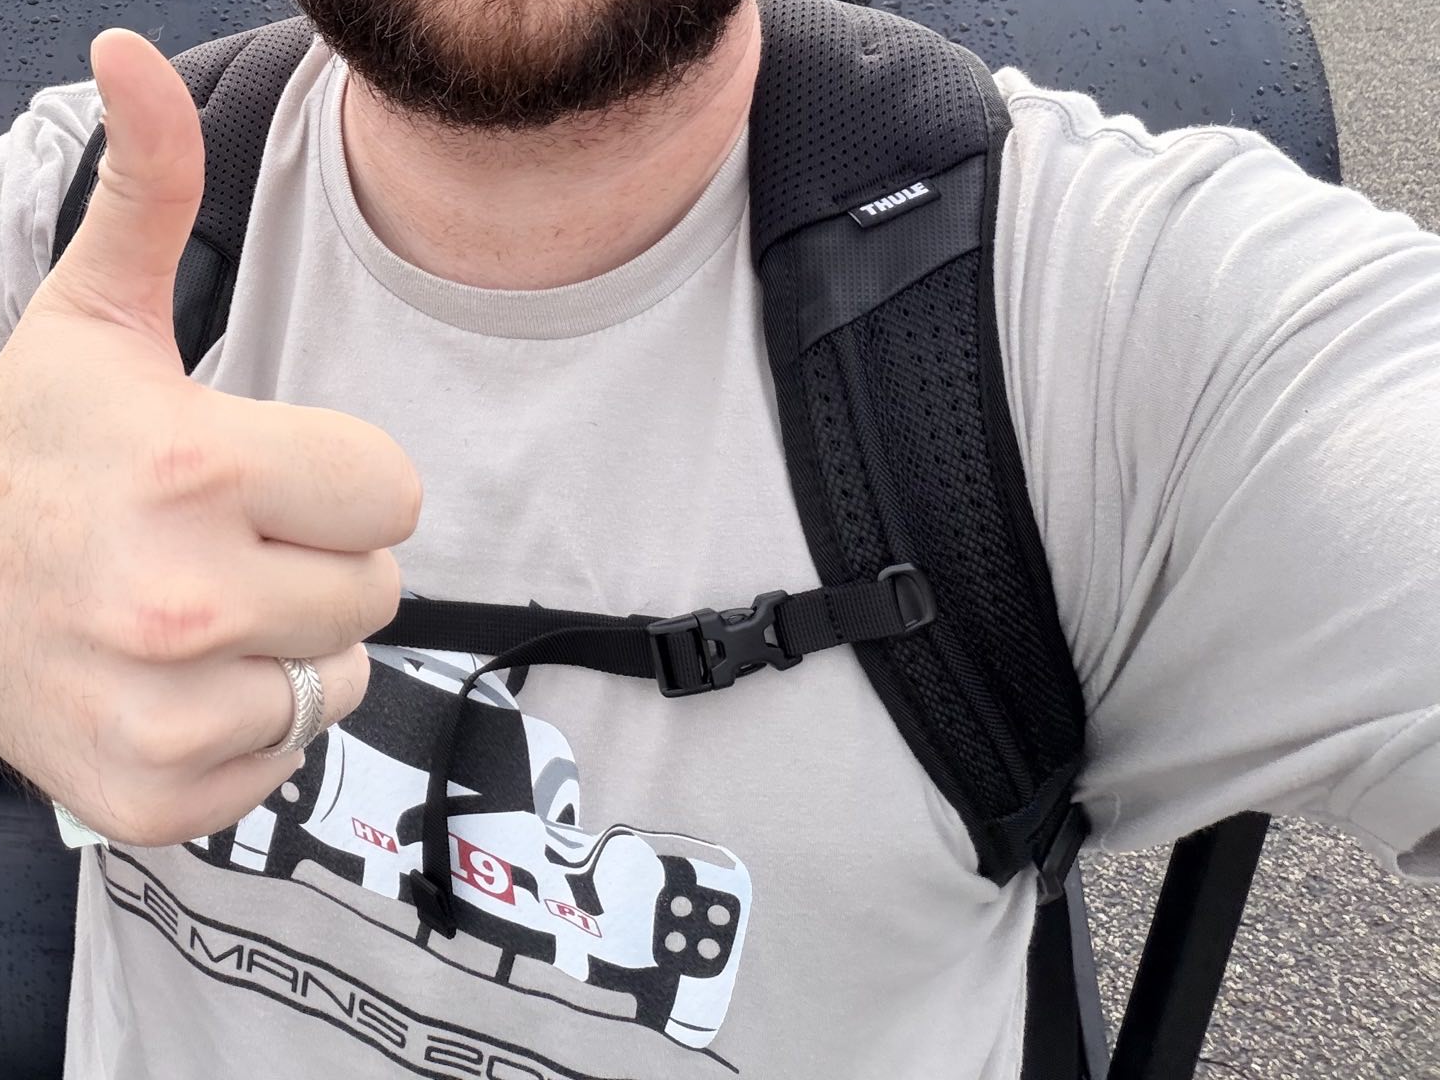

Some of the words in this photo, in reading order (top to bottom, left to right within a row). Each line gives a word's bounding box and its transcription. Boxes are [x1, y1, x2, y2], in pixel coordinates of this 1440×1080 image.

[859, 181, 930, 216] THULE
[352, 822, 395, 850] HY
[556, 904, 591, 930] P1
[188, 925, 409, 1049] MANS
